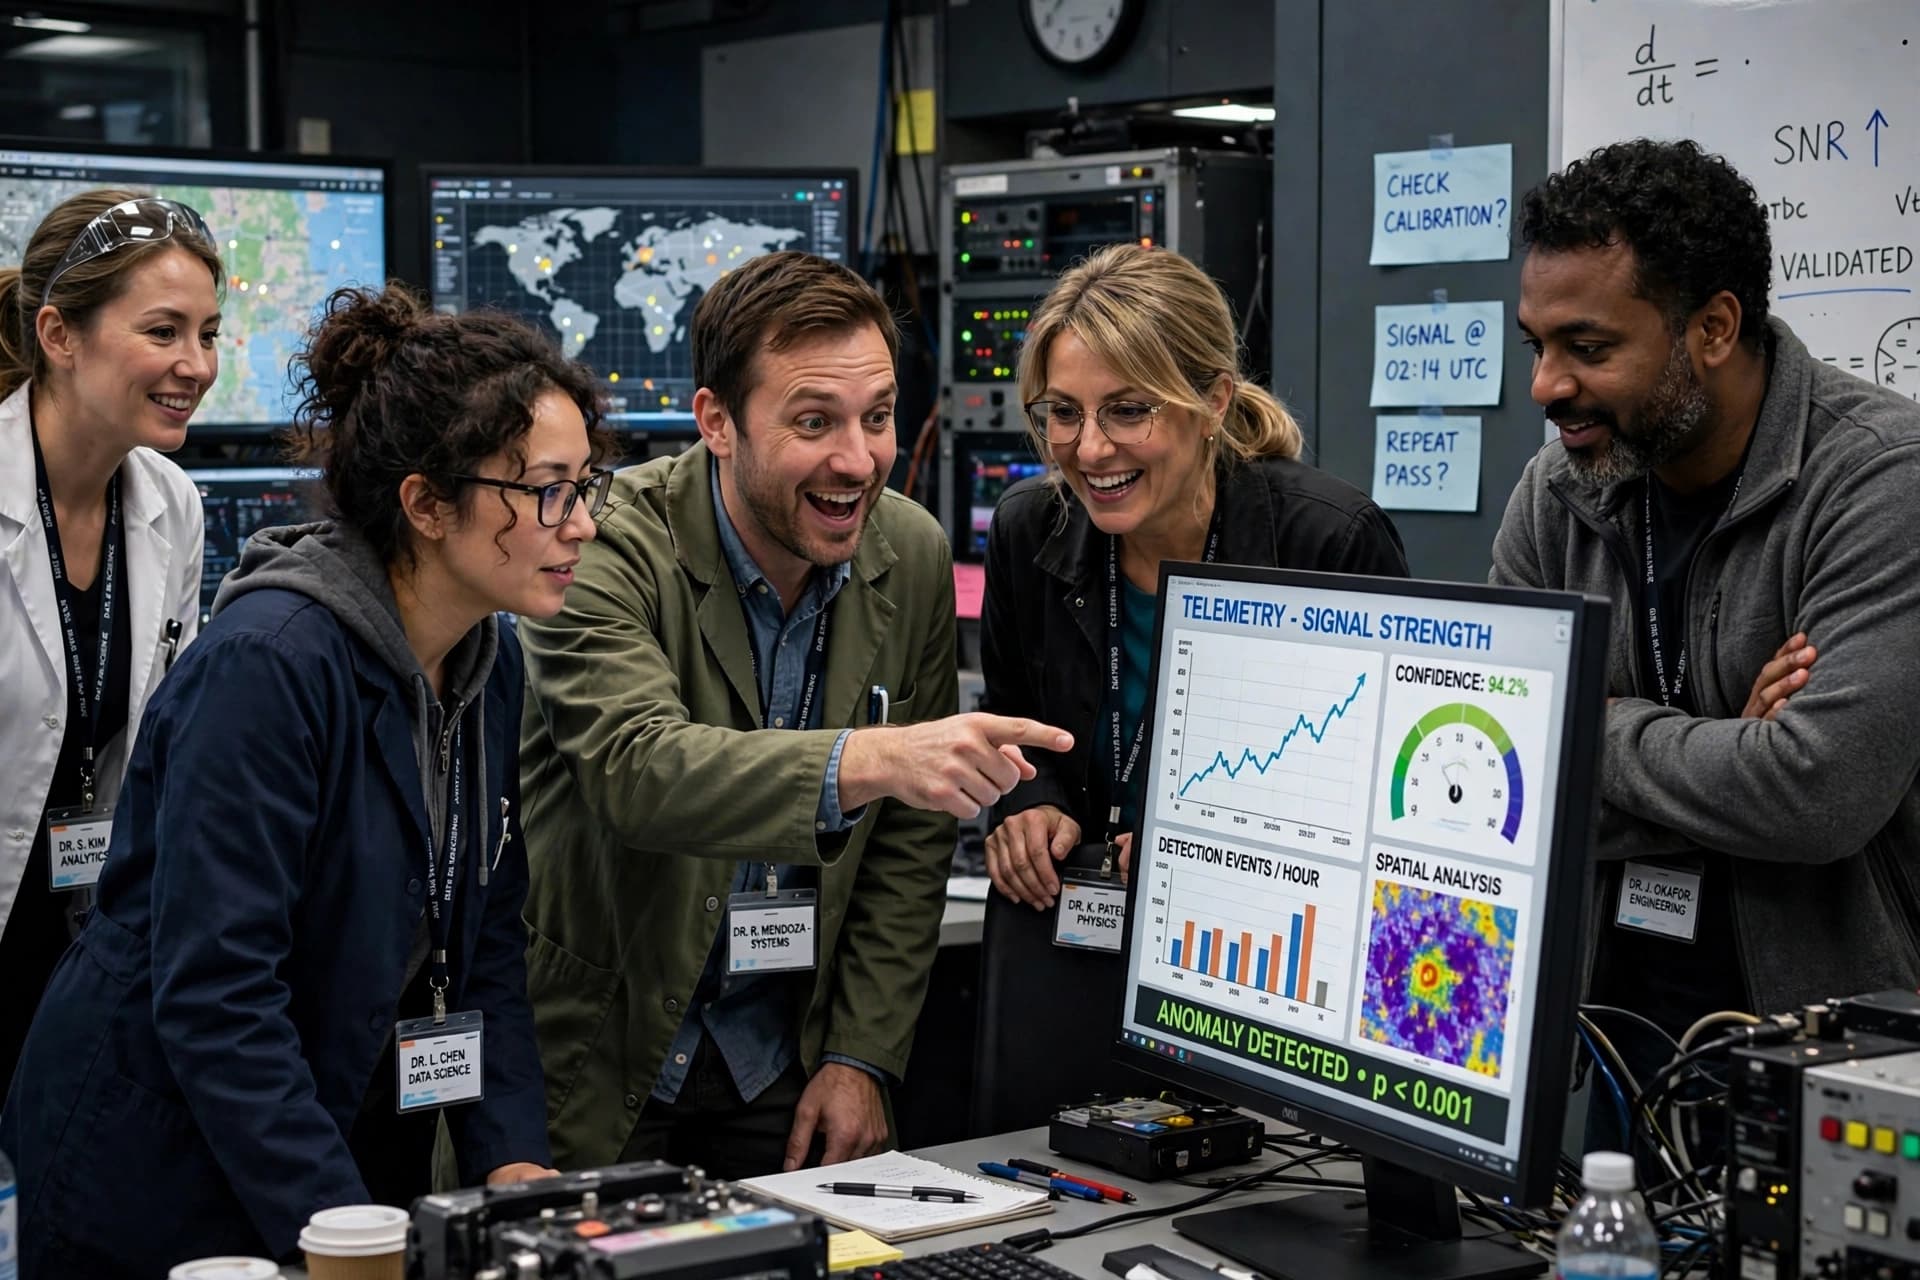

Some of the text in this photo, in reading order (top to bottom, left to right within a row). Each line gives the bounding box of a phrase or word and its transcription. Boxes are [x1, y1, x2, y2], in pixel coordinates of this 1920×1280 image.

[1635, 24, 1655, 65] d
[1637, 74, 1673, 106] dt
[1774, 121, 1848, 164] SNR
[1387, 171, 1450, 198] CHECK
[1384, 198, 1507, 233] CALIBRATION?
[1780, 246, 1913, 281] VALIDATED
[1387, 320, 1485, 347] SIGNAL @
[1385, 358, 1487, 380] 02:14 UTC
[1386, 431, 1459, 453] REPEAT
[1386, 462, 1449, 491] PASS?
[1182, 594, 1286, 628] TELEMETRY
[1302, 607, 1373, 638] SIGNAL
[1379, 614, 1492, 651] STRENGTH
[1395, 664, 1528, 697] CONFIDENCE: 94.2%
[59, 837, 106, 852] DR. S. KIM
[1159, 836, 1320, 888] DETECTION EVENTS / HOUR
[1375, 852, 1502, 896] SPATIAL ANALYSIS
[1629, 878, 1643, 892] DR.
[1645, 882, 1652, 893] J.
[1068, 899, 1125, 917] DR. K. PATEL
[1630, 893, 1686, 916] ENGINEERING
[733, 926, 748, 937] DR.
[750, 925, 759, 936] R.
[762, 923, 806, 936] MENDOZA
[1077, 914, 1117, 929] PHYSICS
[751, 937, 790, 949] SYSTEMS
[411, 1056, 427, 1069] DR.
[440, 1049, 465, 1064] CHEN
[1156, 999, 1245, 1049] ANOMALY
[1247, 1024, 1349, 1083] DETECTED
[1373, 1073, 1388, 1100] p
[1394, 1081, 1407, 1100] <
[1413, 1079, 1473, 1124] 0.001
[409, 1063, 471, 1085] DATA SCIENCE
